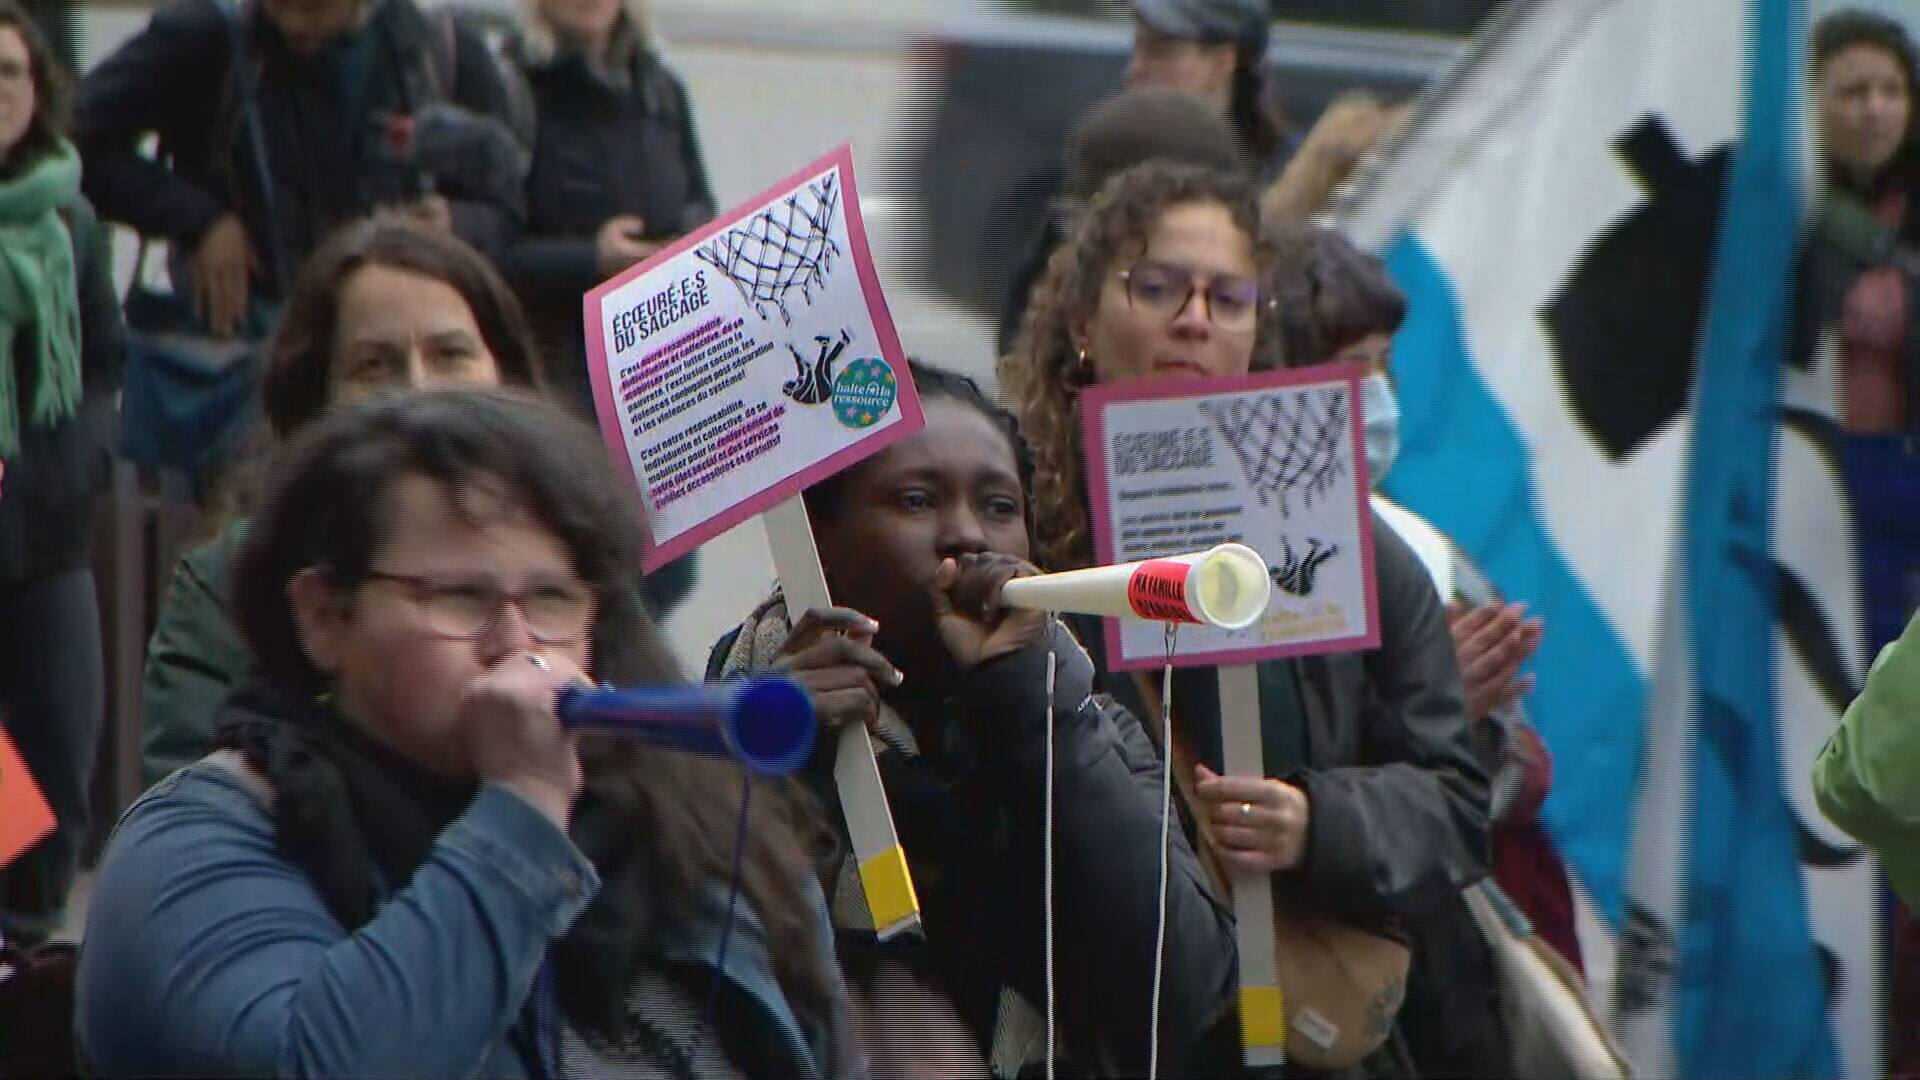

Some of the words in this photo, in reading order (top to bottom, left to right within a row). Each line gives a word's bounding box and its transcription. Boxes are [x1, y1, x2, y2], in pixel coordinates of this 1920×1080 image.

[614, 331, 635, 354] DU
[639, 285, 712, 340] SACCAGE
[742, 337, 755, 352] les
[622, 360, 670, 390] individuelle
[670, 354, 679, 363] et
[721, 322, 733, 334] de
[733, 317, 745, 329] se
[630, 398, 670, 425] violences
[671, 376, 713, 404] conjugales
[714, 341, 775, 378] post-séparation
[664, 365, 683, 381] pour
[684, 351, 706, 370] lutter
[707, 338, 734, 355] contre
[734, 330, 743, 341] la
[633, 425, 643, 437] et
[643, 418, 657, 433] les
[657, 398, 697, 424] violences
[697, 390, 708, 402] du
[709, 369, 746, 397] système!
[644, 441, 693, 474] individuelle
[693, 436, 703, 447] et
[744, 407, 756, 418] de
[756, 401, 768, 413] se
[648, 457, 687, 485] mobiliser
[688, 449, 707, 466] pour
[707, 443, 716, 452] le
[716, 411, 773, 448] renforcement
[773, 404, 786, 417] de
[662, 432, 684, 448] notre
[674, 469, 692, 485] filet
[692, 456, 717, 475] social
[718, 449, 728, 459] et
[727, 441, 743, 455] des
[743, 423, 780, 449] services
[686, 460, 736, 494] accessibles
[735, 454, 746, 466] et
[745, 433, 782, 462] gratuits!
[1133, 572, 1147, 592] MA
[1147, 575, 1184, 601] FAMILLE
